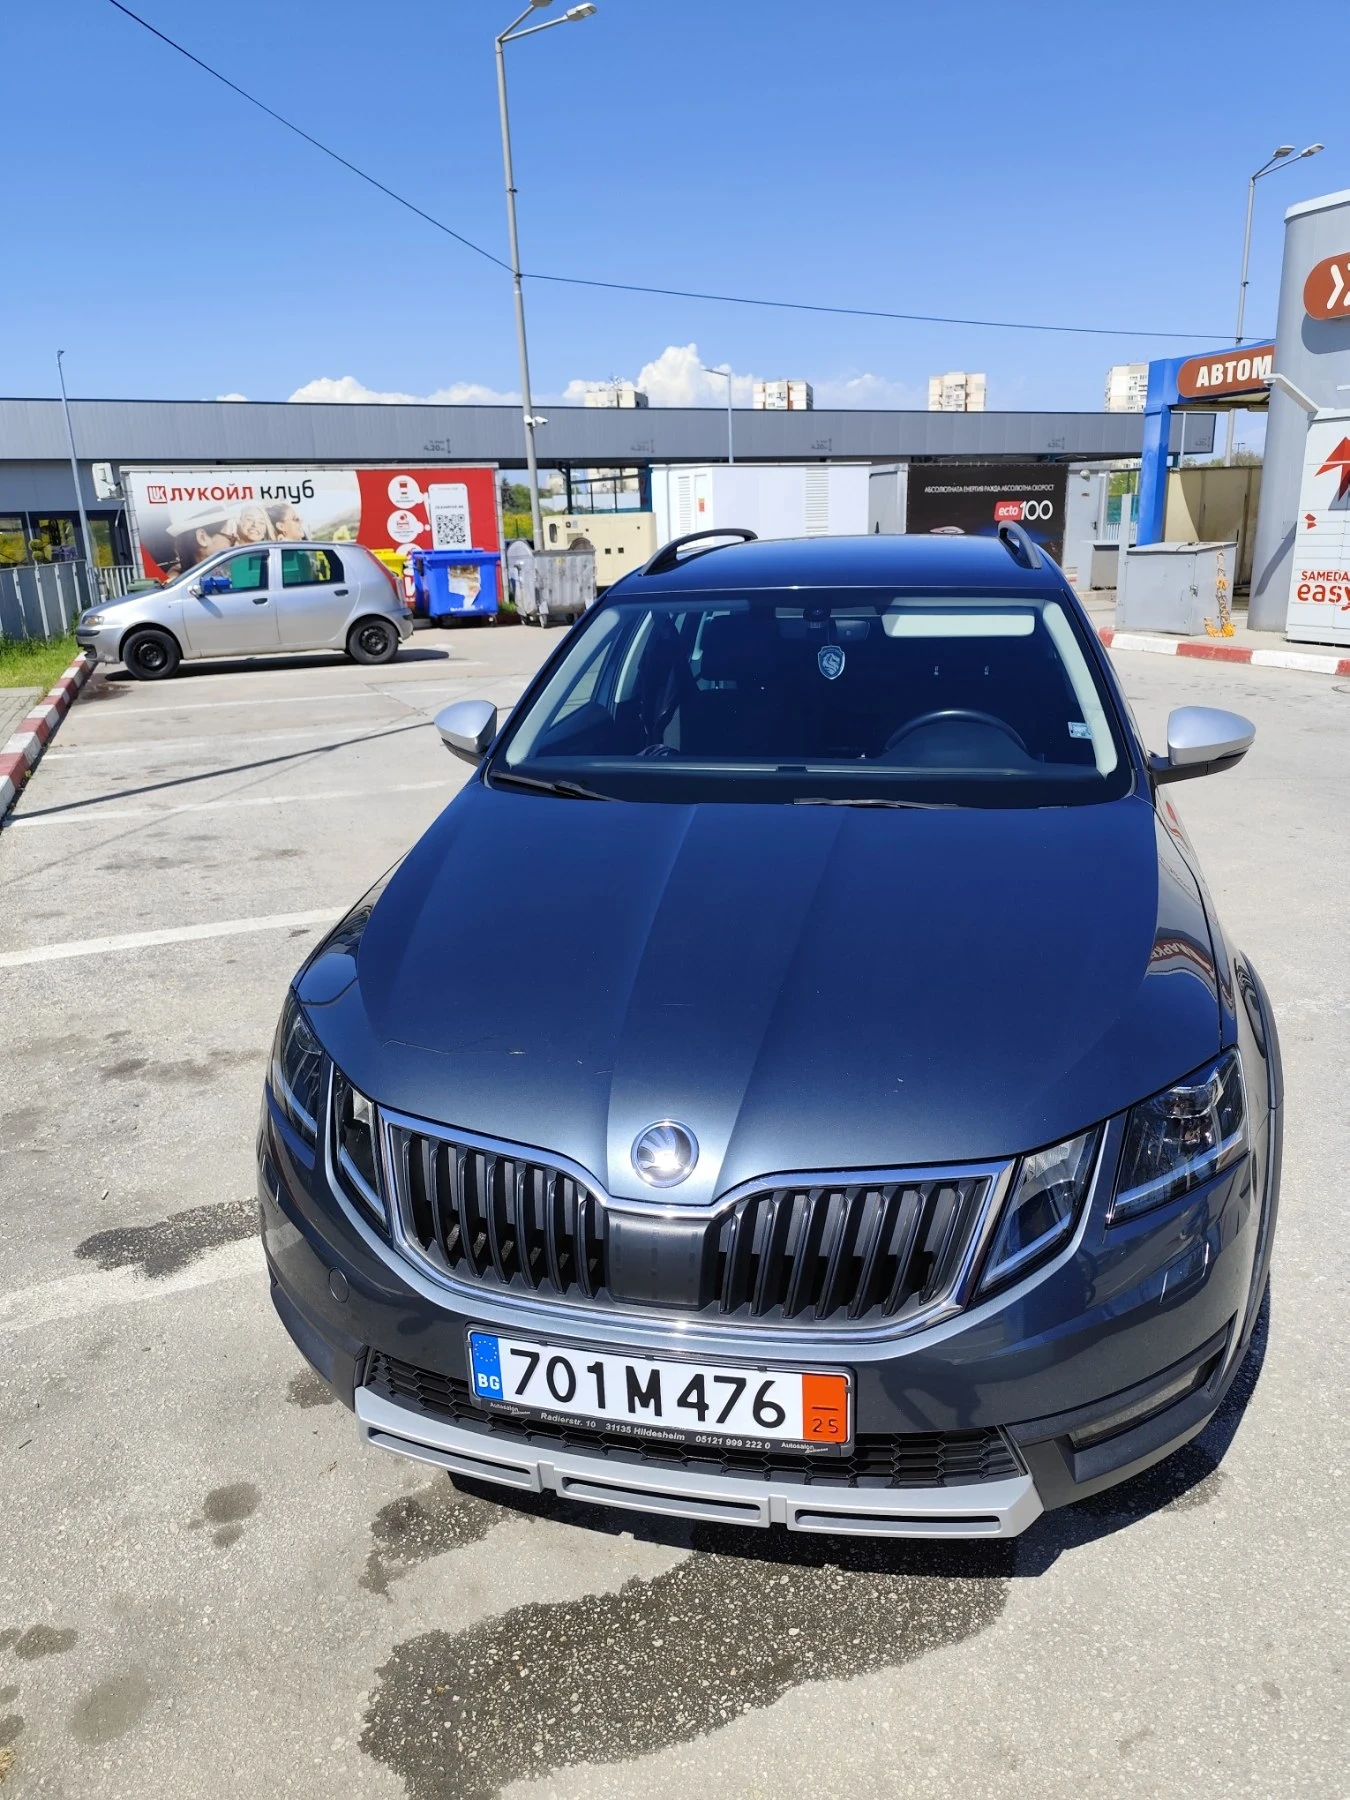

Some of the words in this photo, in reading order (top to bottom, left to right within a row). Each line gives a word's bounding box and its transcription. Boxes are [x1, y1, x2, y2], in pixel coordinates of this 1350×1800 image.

[170, 483, 254, 501] ЛУКОЙЛ
[260, 479, 315, 504] клуб
[477, 1372, 500, 1391] BG
[585, 1420, 597, 1429] 10
[605, 1422, 632, 1434] 31135
[633, 1427, 686, 1441] Hildesheim
[695, 1434, 723, 1445] 05121
[725, 1438, 743, 1447] 999
[745, 1440, 762, 1449] 222
[764, 1442, 771, 1450] 0
[812, 1418, 839, 1434] 25
[781, 1441, 815, 1451] Autosalon
